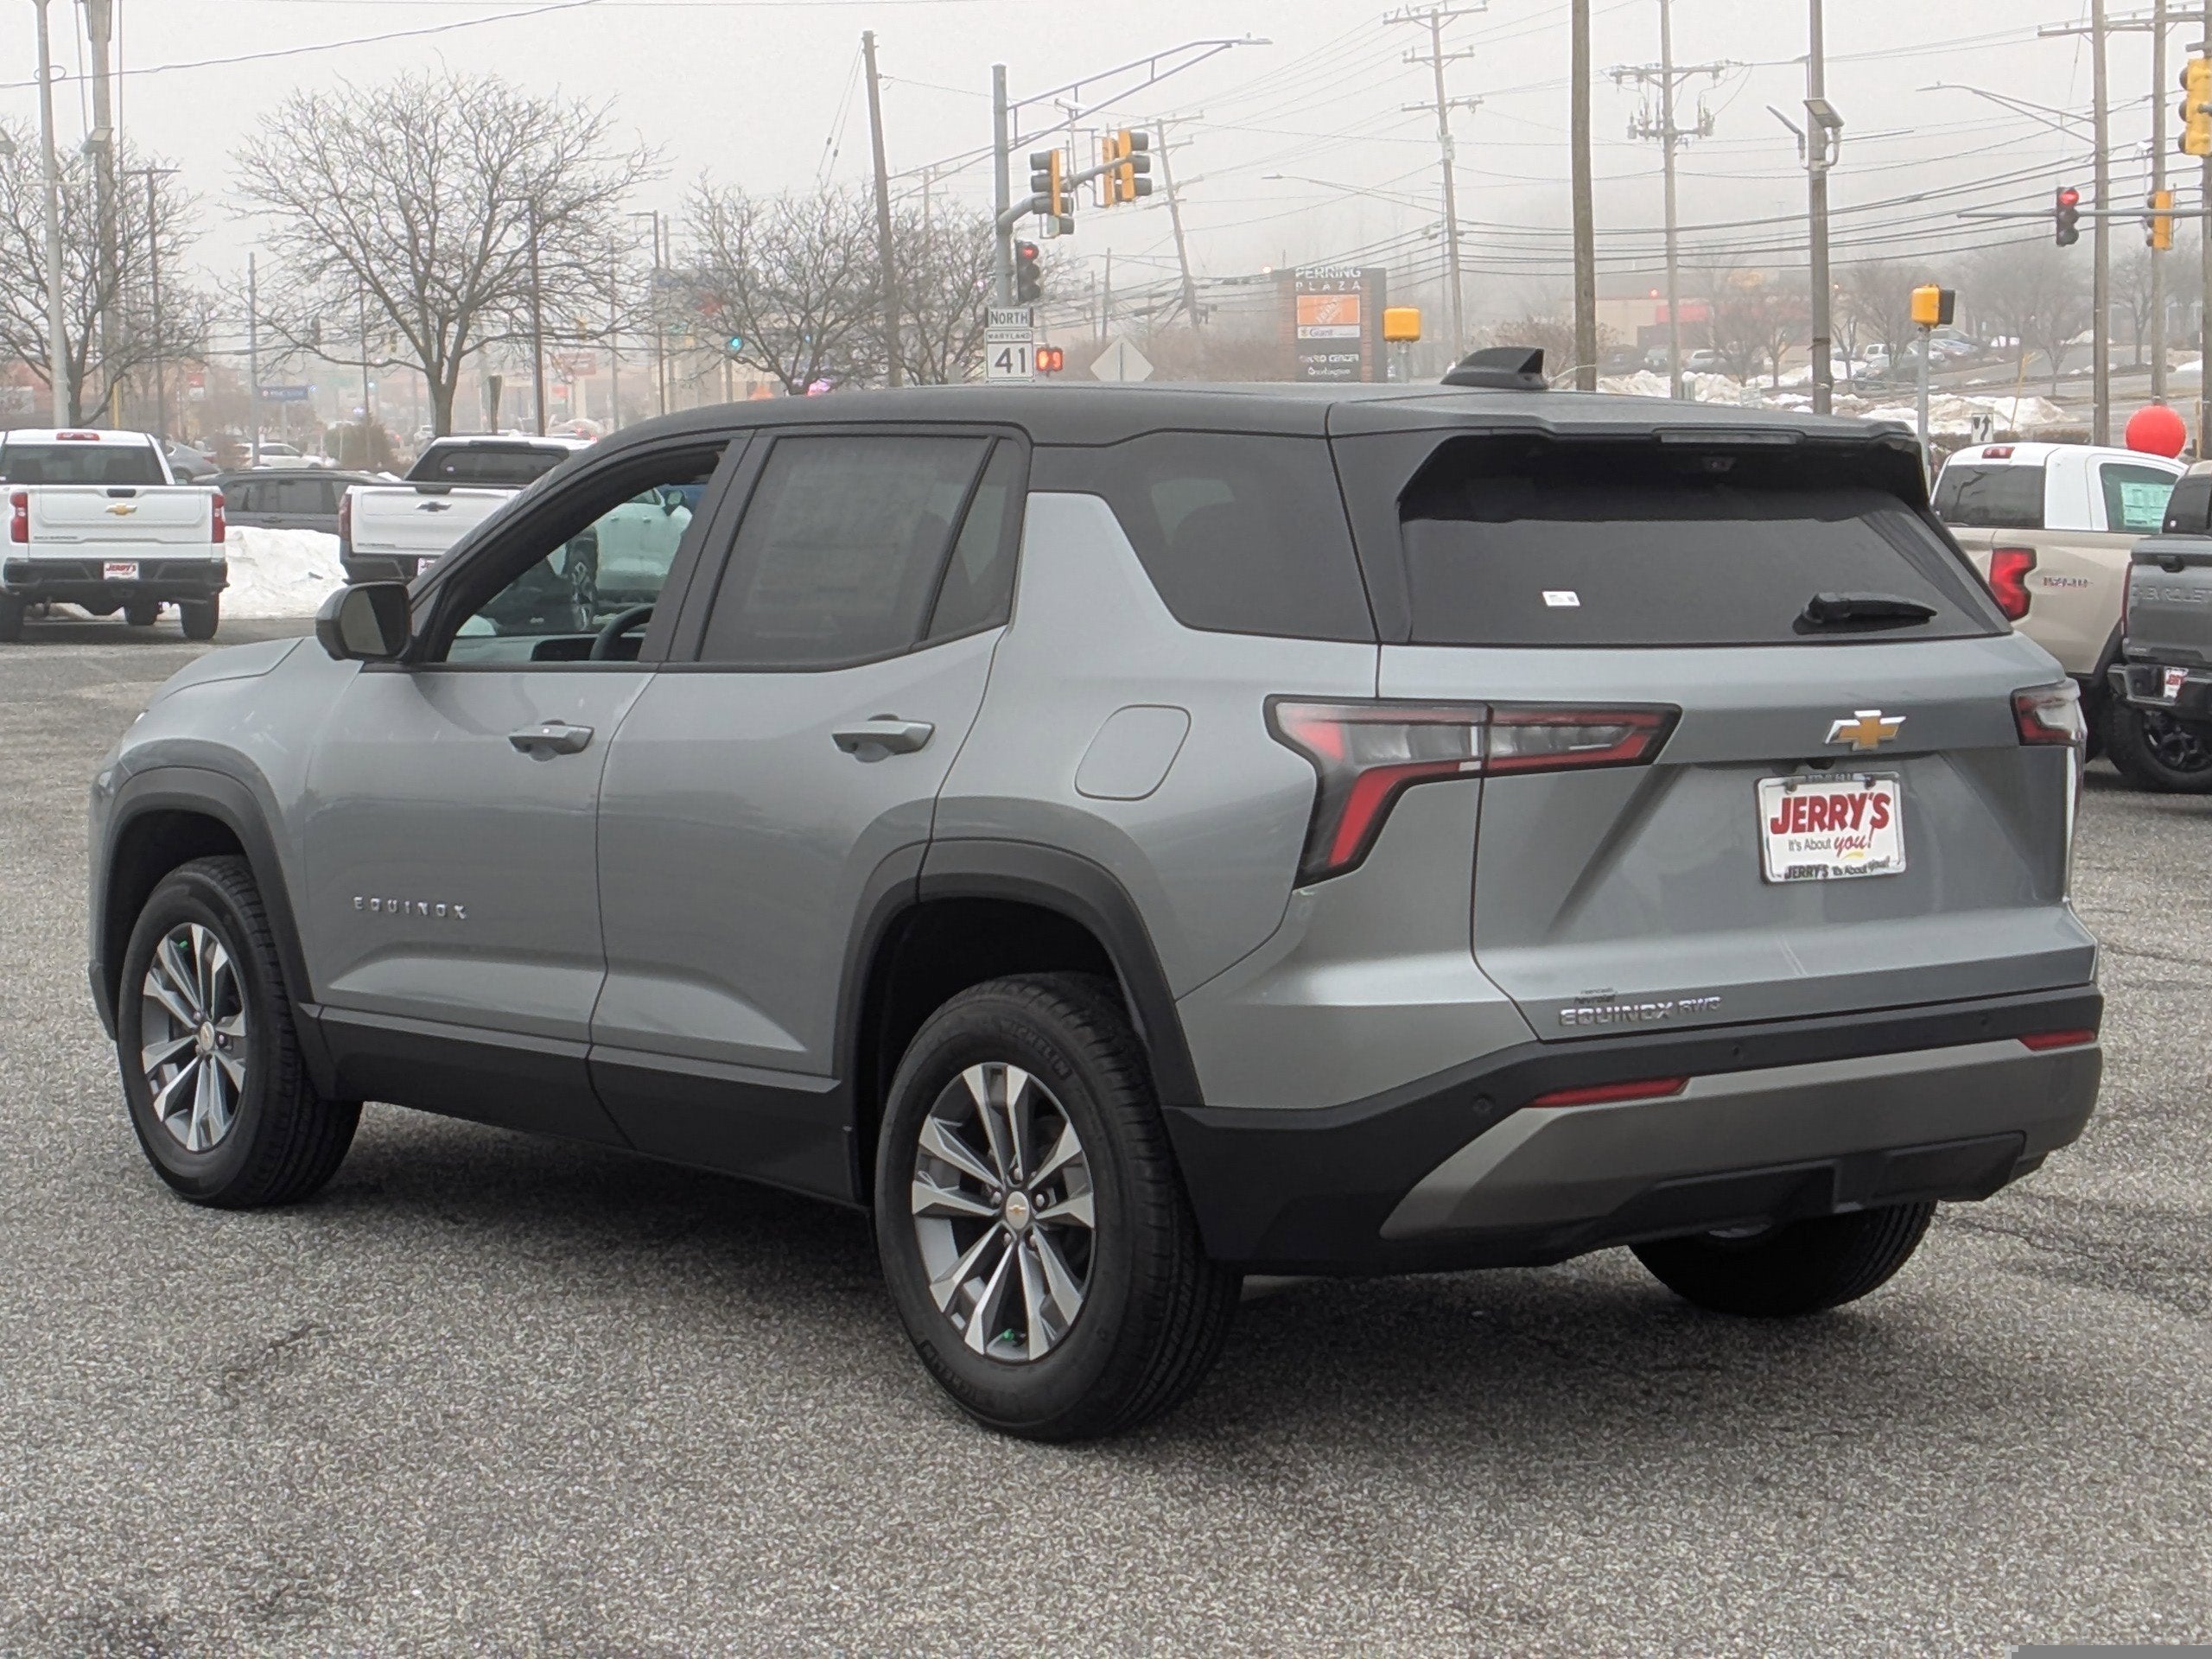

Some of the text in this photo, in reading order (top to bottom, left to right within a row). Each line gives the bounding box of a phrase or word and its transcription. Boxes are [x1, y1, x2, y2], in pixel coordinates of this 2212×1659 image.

[1295, 266, 1362, 279] PERRING
[1296, 281, 1361, 291] PLAZA
[990, 312, 1028, 324] NORTH
[995, 347, 1026, 373] 41
[1770, 792, 1891, 835] JERRY'S
[1789, 828, 1873, 858] It's About you!
[1784, 864, 1828, 879] JERRY'S
[353, 896, 467, 919] EQUINOX
[1559, 1002, 1673, 1026] EQUINOX
